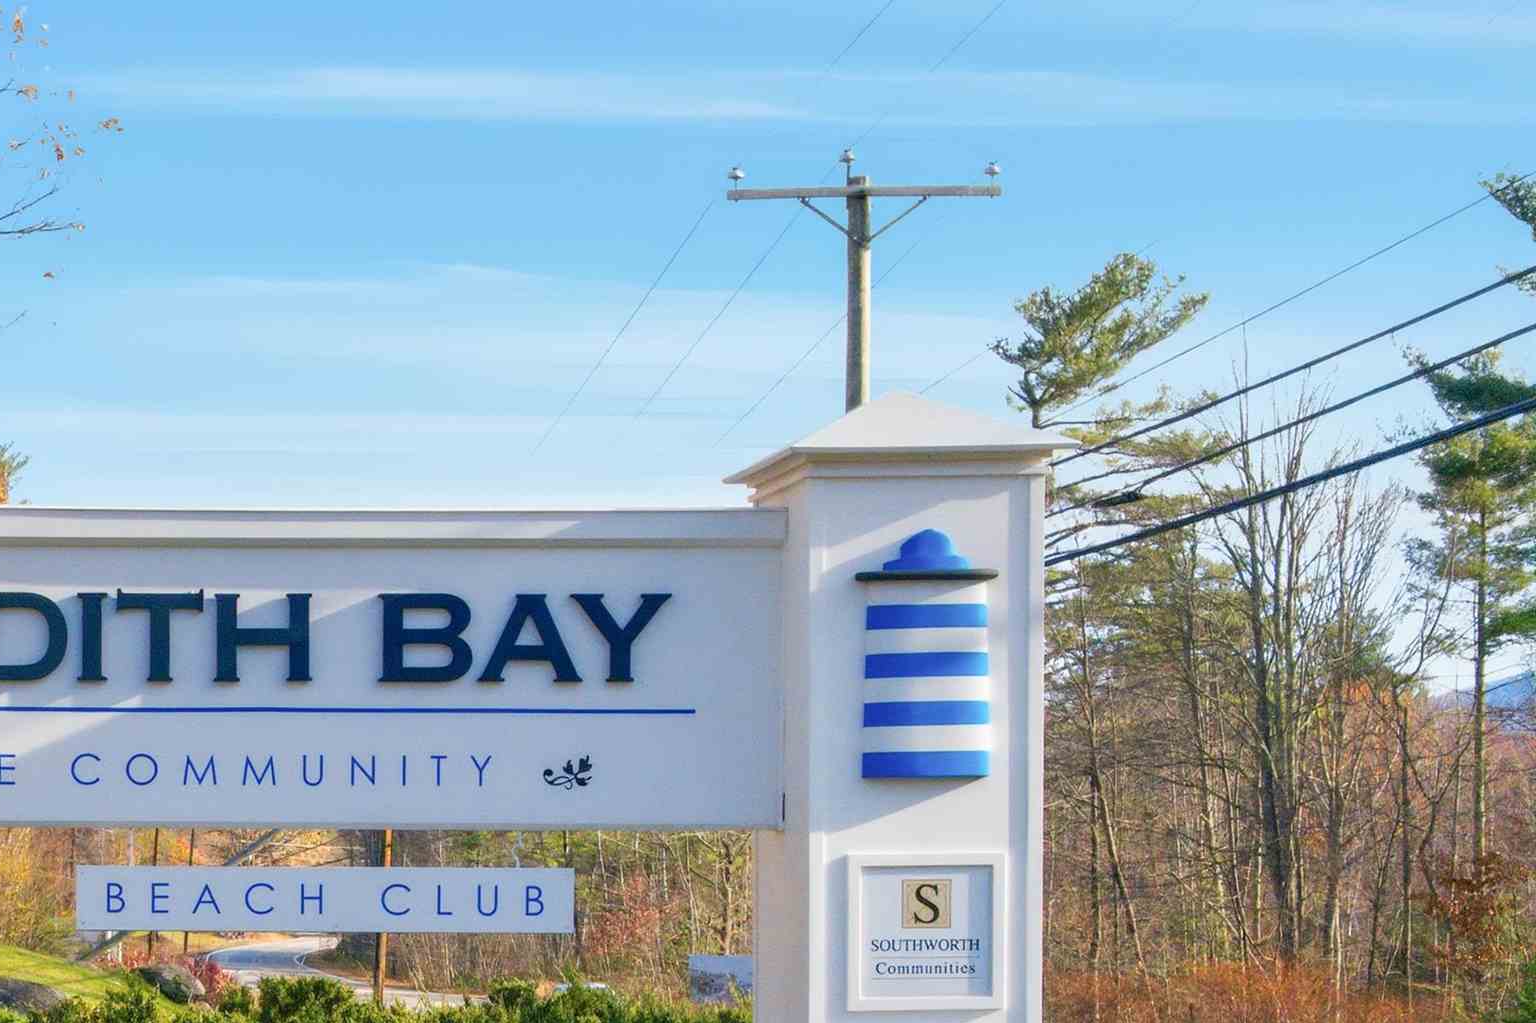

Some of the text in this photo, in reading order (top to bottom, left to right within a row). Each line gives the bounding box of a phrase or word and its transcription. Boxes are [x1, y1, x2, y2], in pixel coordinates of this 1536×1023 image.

[377, 592, 673, 683] BAY
[69, 752, 494, 787] COMMUNITY
[105, 882, 547, 918] BEACH CLUB
[913, 883, 940, 924] S
[870, 938, 980, 952] SOUTHWORTH
[875, 961, 976, 975] Communities
